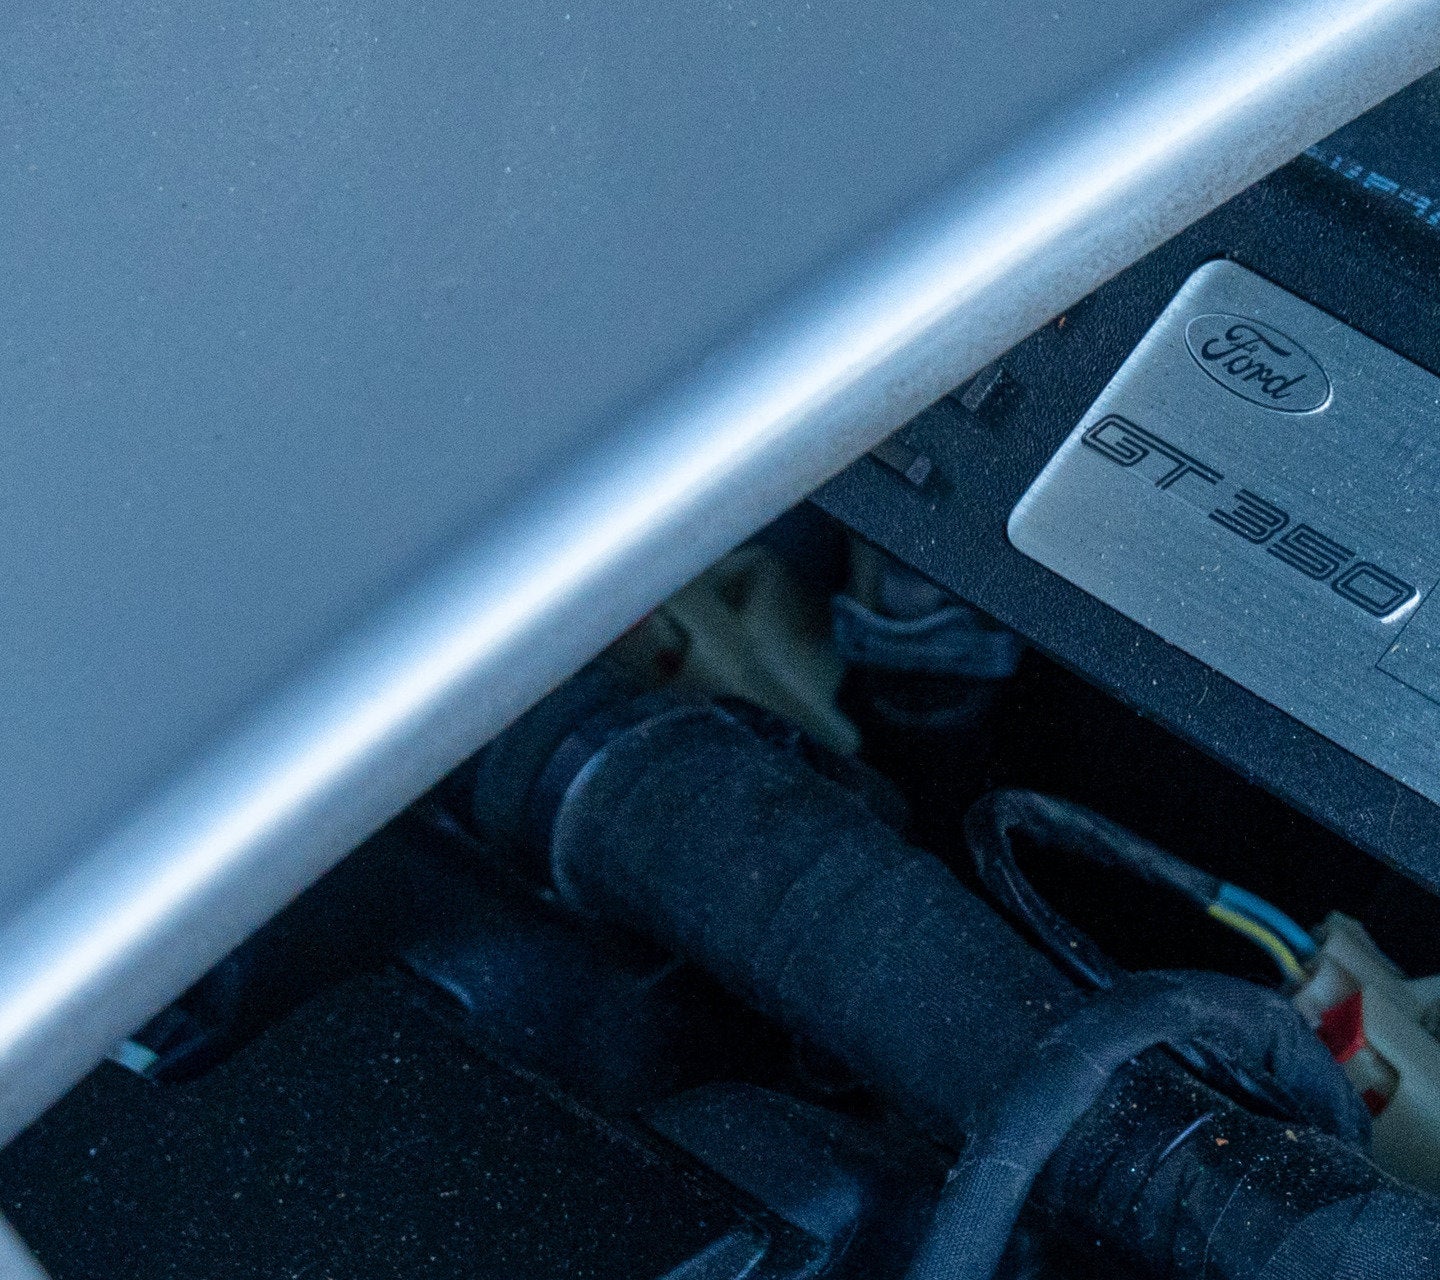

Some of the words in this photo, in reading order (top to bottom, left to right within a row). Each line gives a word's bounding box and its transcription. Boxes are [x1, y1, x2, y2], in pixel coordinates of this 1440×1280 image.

[1201, 323, 1308, 400] Ford
[1081, 413, 1224, 491] GT
[1210, 488, 1420, 620] 350
